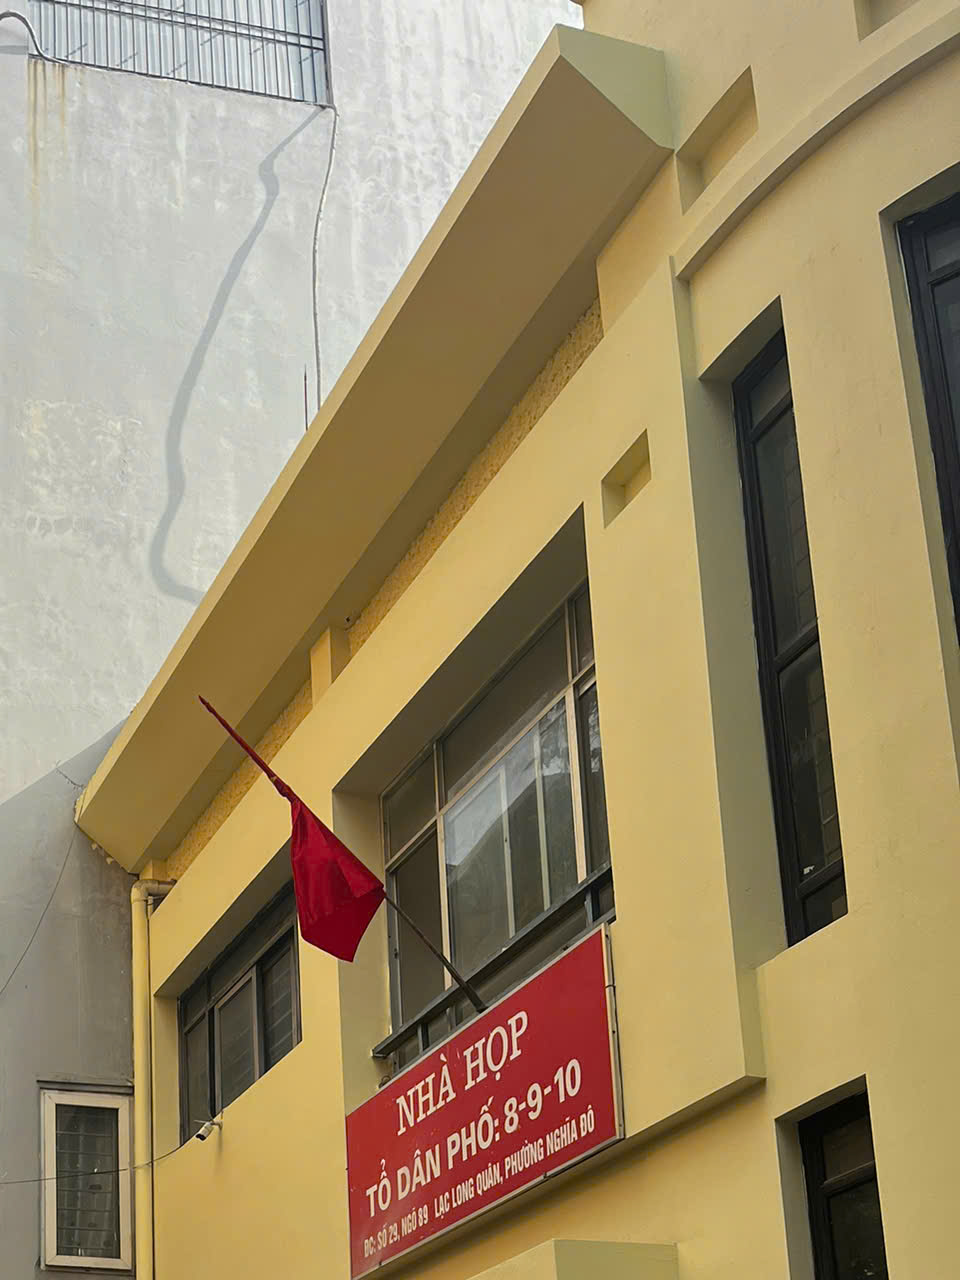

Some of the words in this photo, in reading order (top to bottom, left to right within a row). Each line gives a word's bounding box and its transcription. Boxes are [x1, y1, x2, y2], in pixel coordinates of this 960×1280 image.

[396, 1053, 456, 1136] NHÀ
[463, 1010, 529, 1091] HỌP
[366, 1158, 392, 1218] TỔ
[396, 1144, 441, 1201] DÂN
[447, 1096, 500, 1170] PHỐ:
[377, 1222, 387, 1251] SỐ
[418, 1204, 429, 1228] 89
[434, 1191, 451, 1220] LẠC
[451, 1177, 475, 1209] LONG
[476, 1161, 504, 1196] QUÂN,
[504, 1139, 544, 1180] PHƯỜNG
[580, 1104, 595, 1138] ĐÔ
